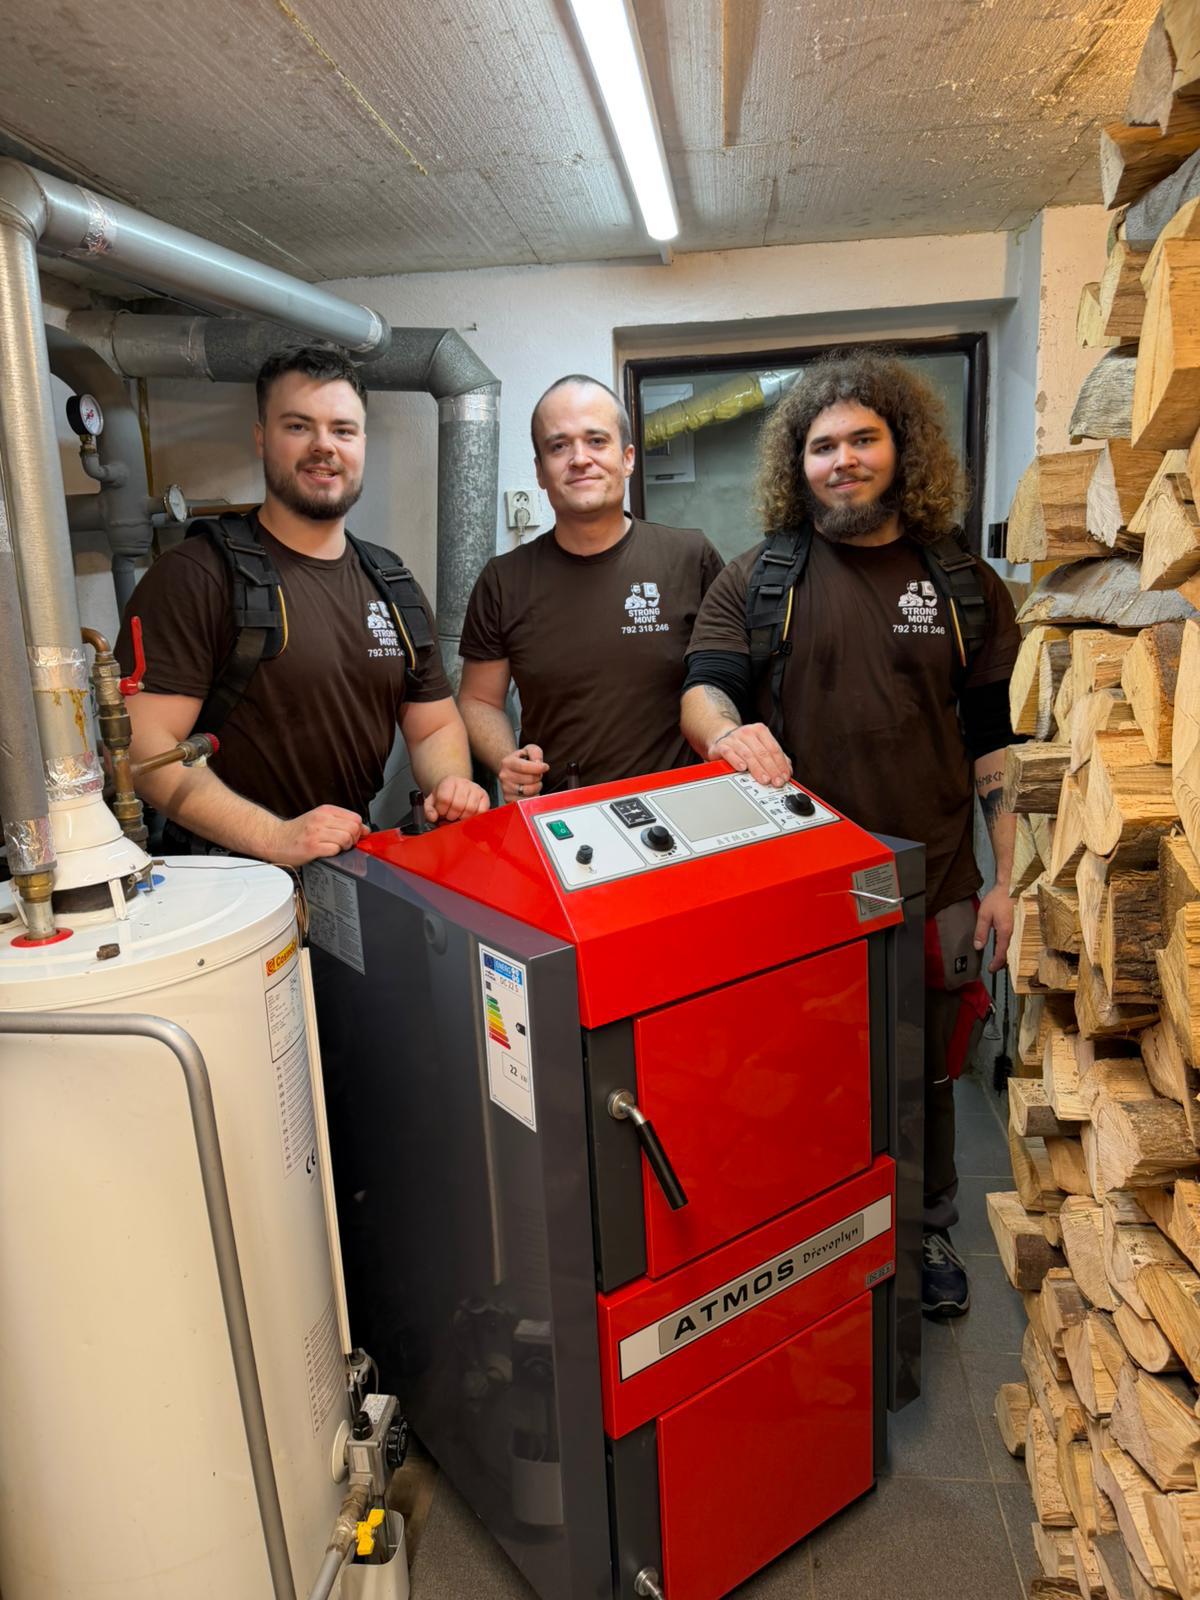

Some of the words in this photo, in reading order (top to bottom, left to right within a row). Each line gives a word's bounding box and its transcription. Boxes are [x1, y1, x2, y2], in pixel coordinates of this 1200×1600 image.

[628, 608, 661, 617] STRONG
[902, 607, 938, 616] STRONG
[634, 616, 657, 624] MOVE
[907, 615, 934, 624] MOVE
[621, 626, 637, 634] 792
[638, 625, 654, 633] 318
[654, 624, 669, 632] 246
[892, 624, 910, 633] 792
[912, 625, 928, 633] 318
[930, 626, 946, 635] 246
[379, 637, 398, 646] MOVE
[368, 649, 383, 657] 792
[384, 648, 396, 656] 318
[716, 830, 757, 846] ATMOS
[509, 1064, 518, 1077] 22
[673, 1259, 795, 1341] ATMOS
[802, 1227, 859, 1264] Dřevoplyn
